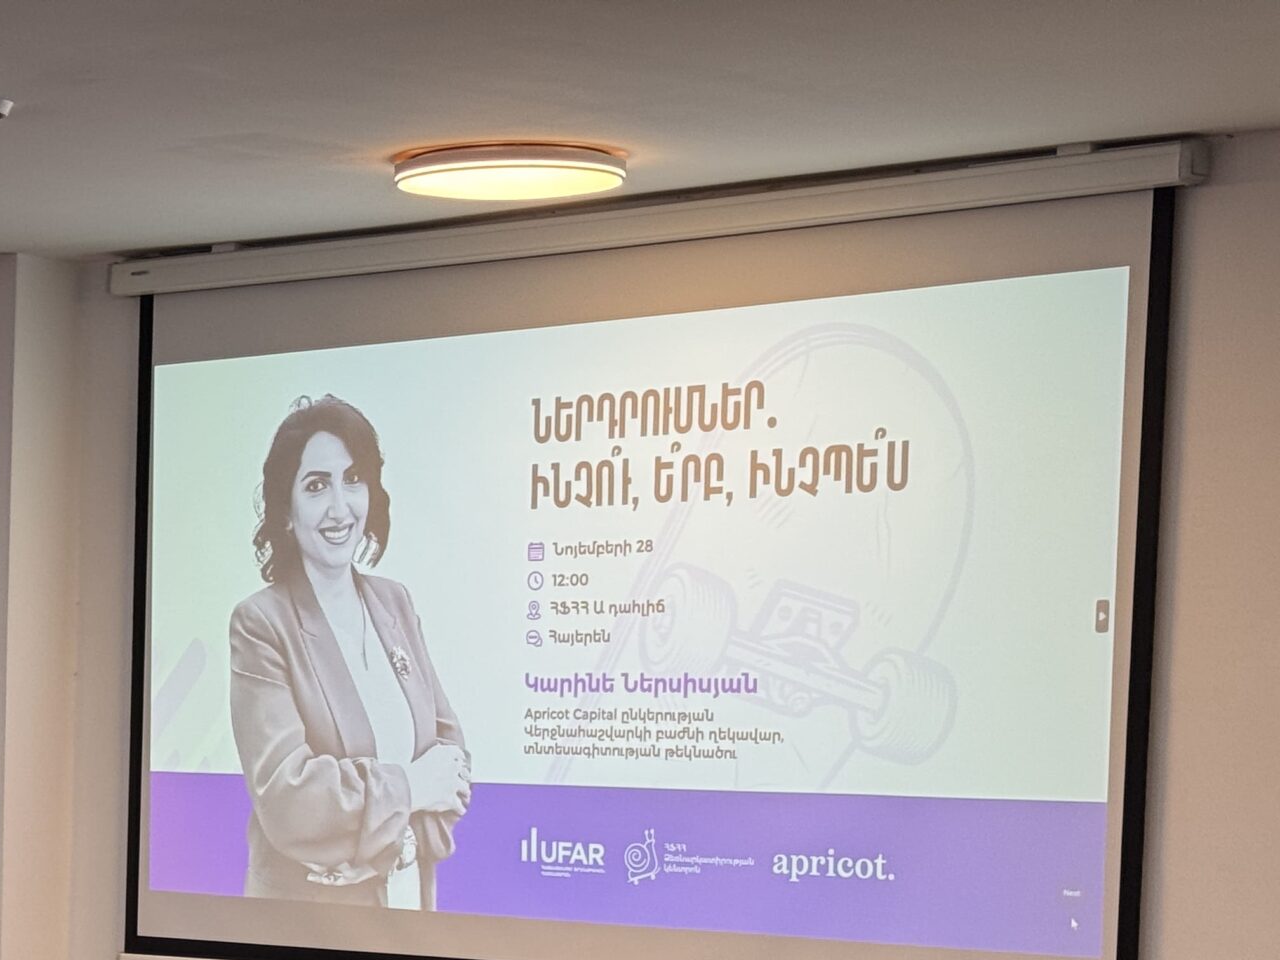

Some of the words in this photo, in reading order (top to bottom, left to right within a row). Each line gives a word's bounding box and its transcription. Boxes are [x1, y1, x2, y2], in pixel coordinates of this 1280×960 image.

[552, 539, 632, 559] Նոյեմբերի
[635, 539, 654, 553] 28
[551, 573, 589, 587] 12:00
[593, 600, 605, 615] Ա
[608, 599, 666, 618] դահլիճ
[548, 629, 611, 647] Հայերեն
[524, 672, 616, 699] Կարինե
[620, 672, 759, 699] Ներսիսյան
[523, 707, 570, 723] Apricot
[572, 707, 618, 724] Capital
[621, 708, 715, 725] ընկերության
[523, 724, 652, 743] Վերջնահաշվարկի
[656, 726, 705, 744] բաժնի
[708, 727, 784, 745] ղեկավար,
[523, 742, 661, 760] տնտեսագիտության
[664, 744, 738, 762] թեկնածու
[540, 839, 606, 867] UFAR
[772, 848, 895, 883] apricot.
